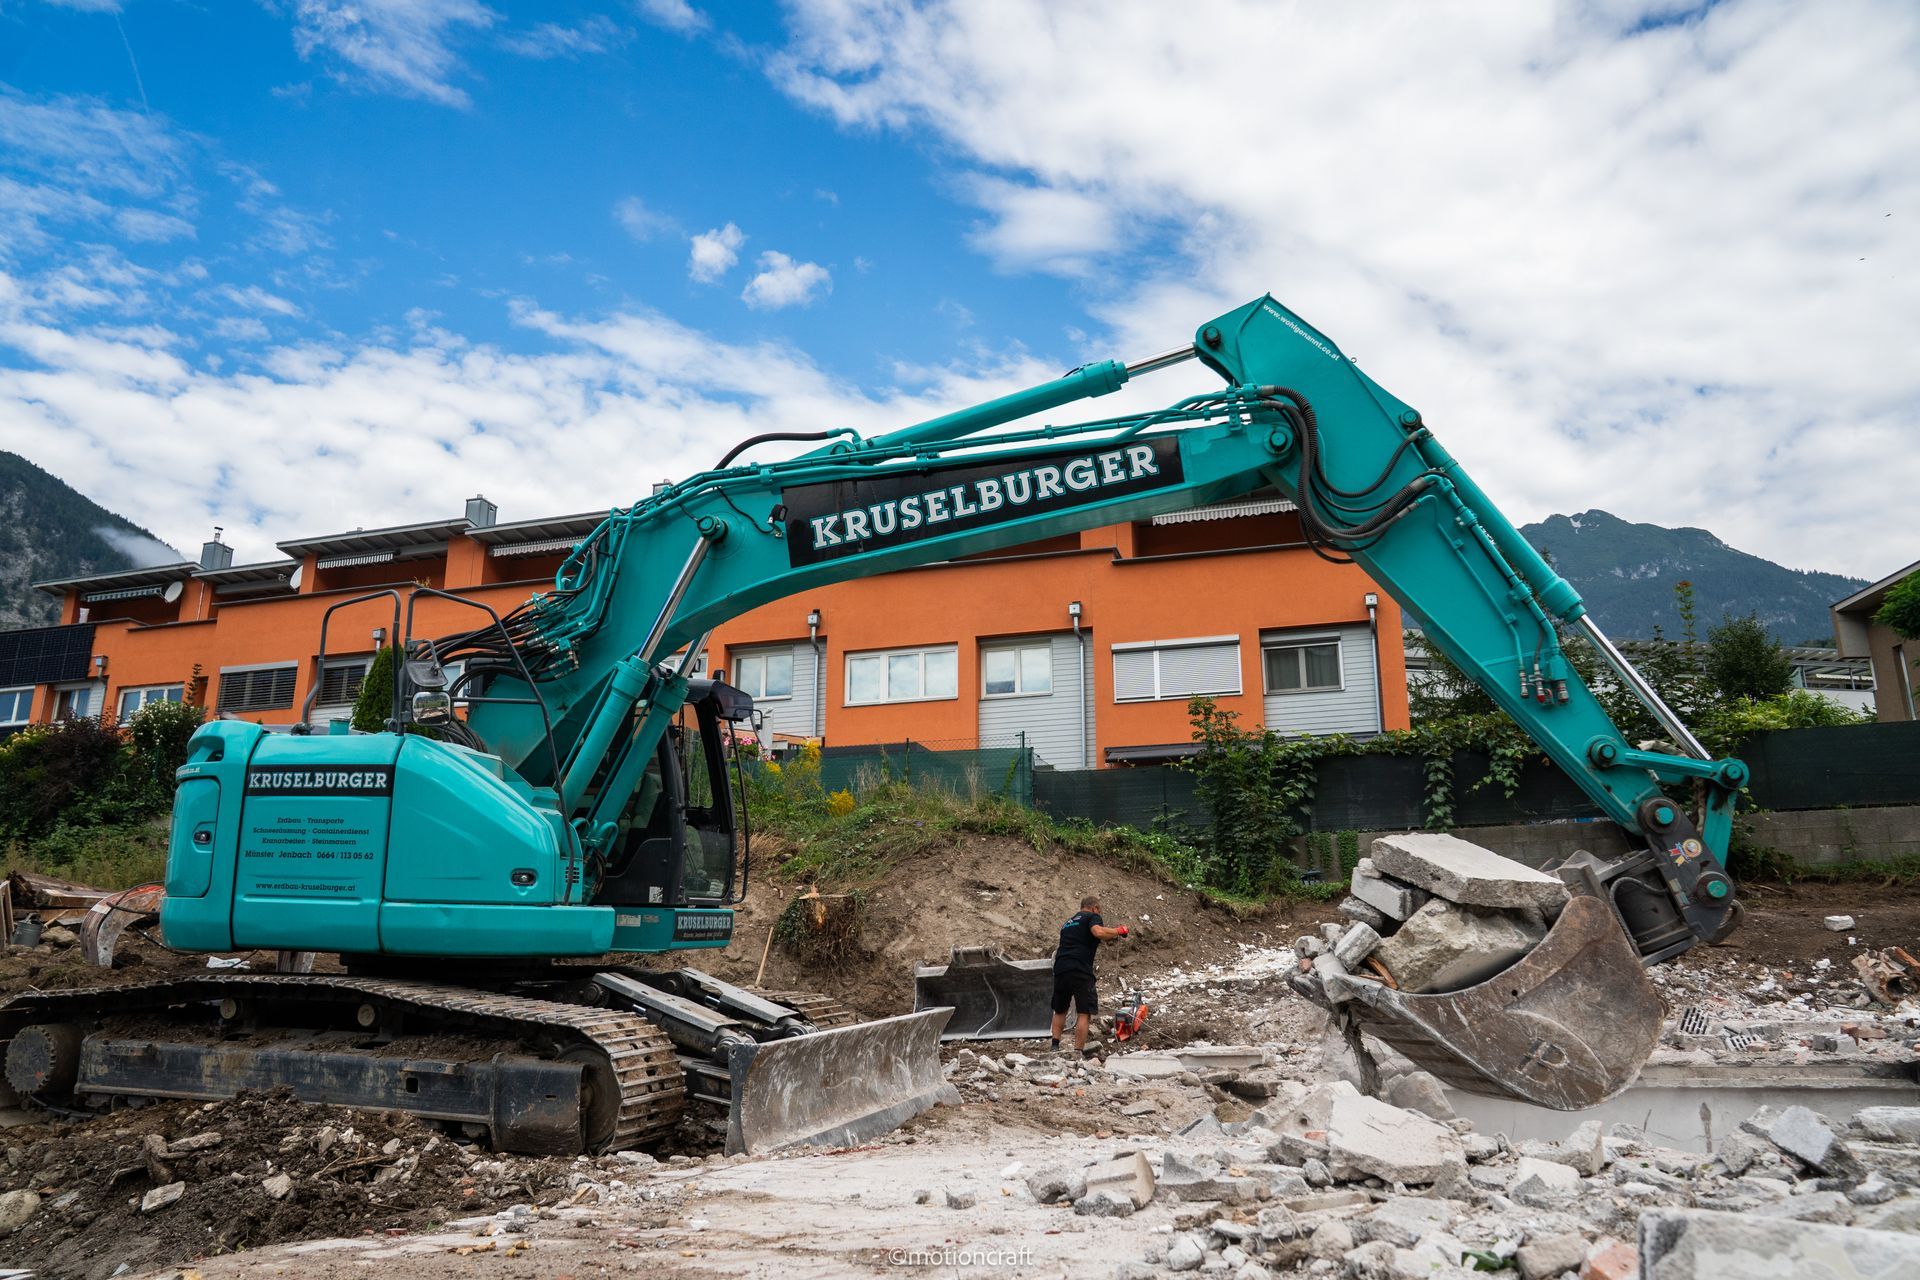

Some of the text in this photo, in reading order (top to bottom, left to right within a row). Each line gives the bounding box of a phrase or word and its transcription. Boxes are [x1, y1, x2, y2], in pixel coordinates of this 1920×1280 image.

[811, 445, 1159, 549] KRUSELBURGER
[248, 772, 387, 788] KRUSELBURGER
[307, 817, 345, 825] Transporte
[312, 827, 370, 835] Containerdienst
[245, 850, 274, 858] Münster
[279, 850, 312, 859] Jenbach
[255, 883, 356, 893] www.erdbau-kruselburger.at
[677, 916, 731, 929] KRUSELBURGER
